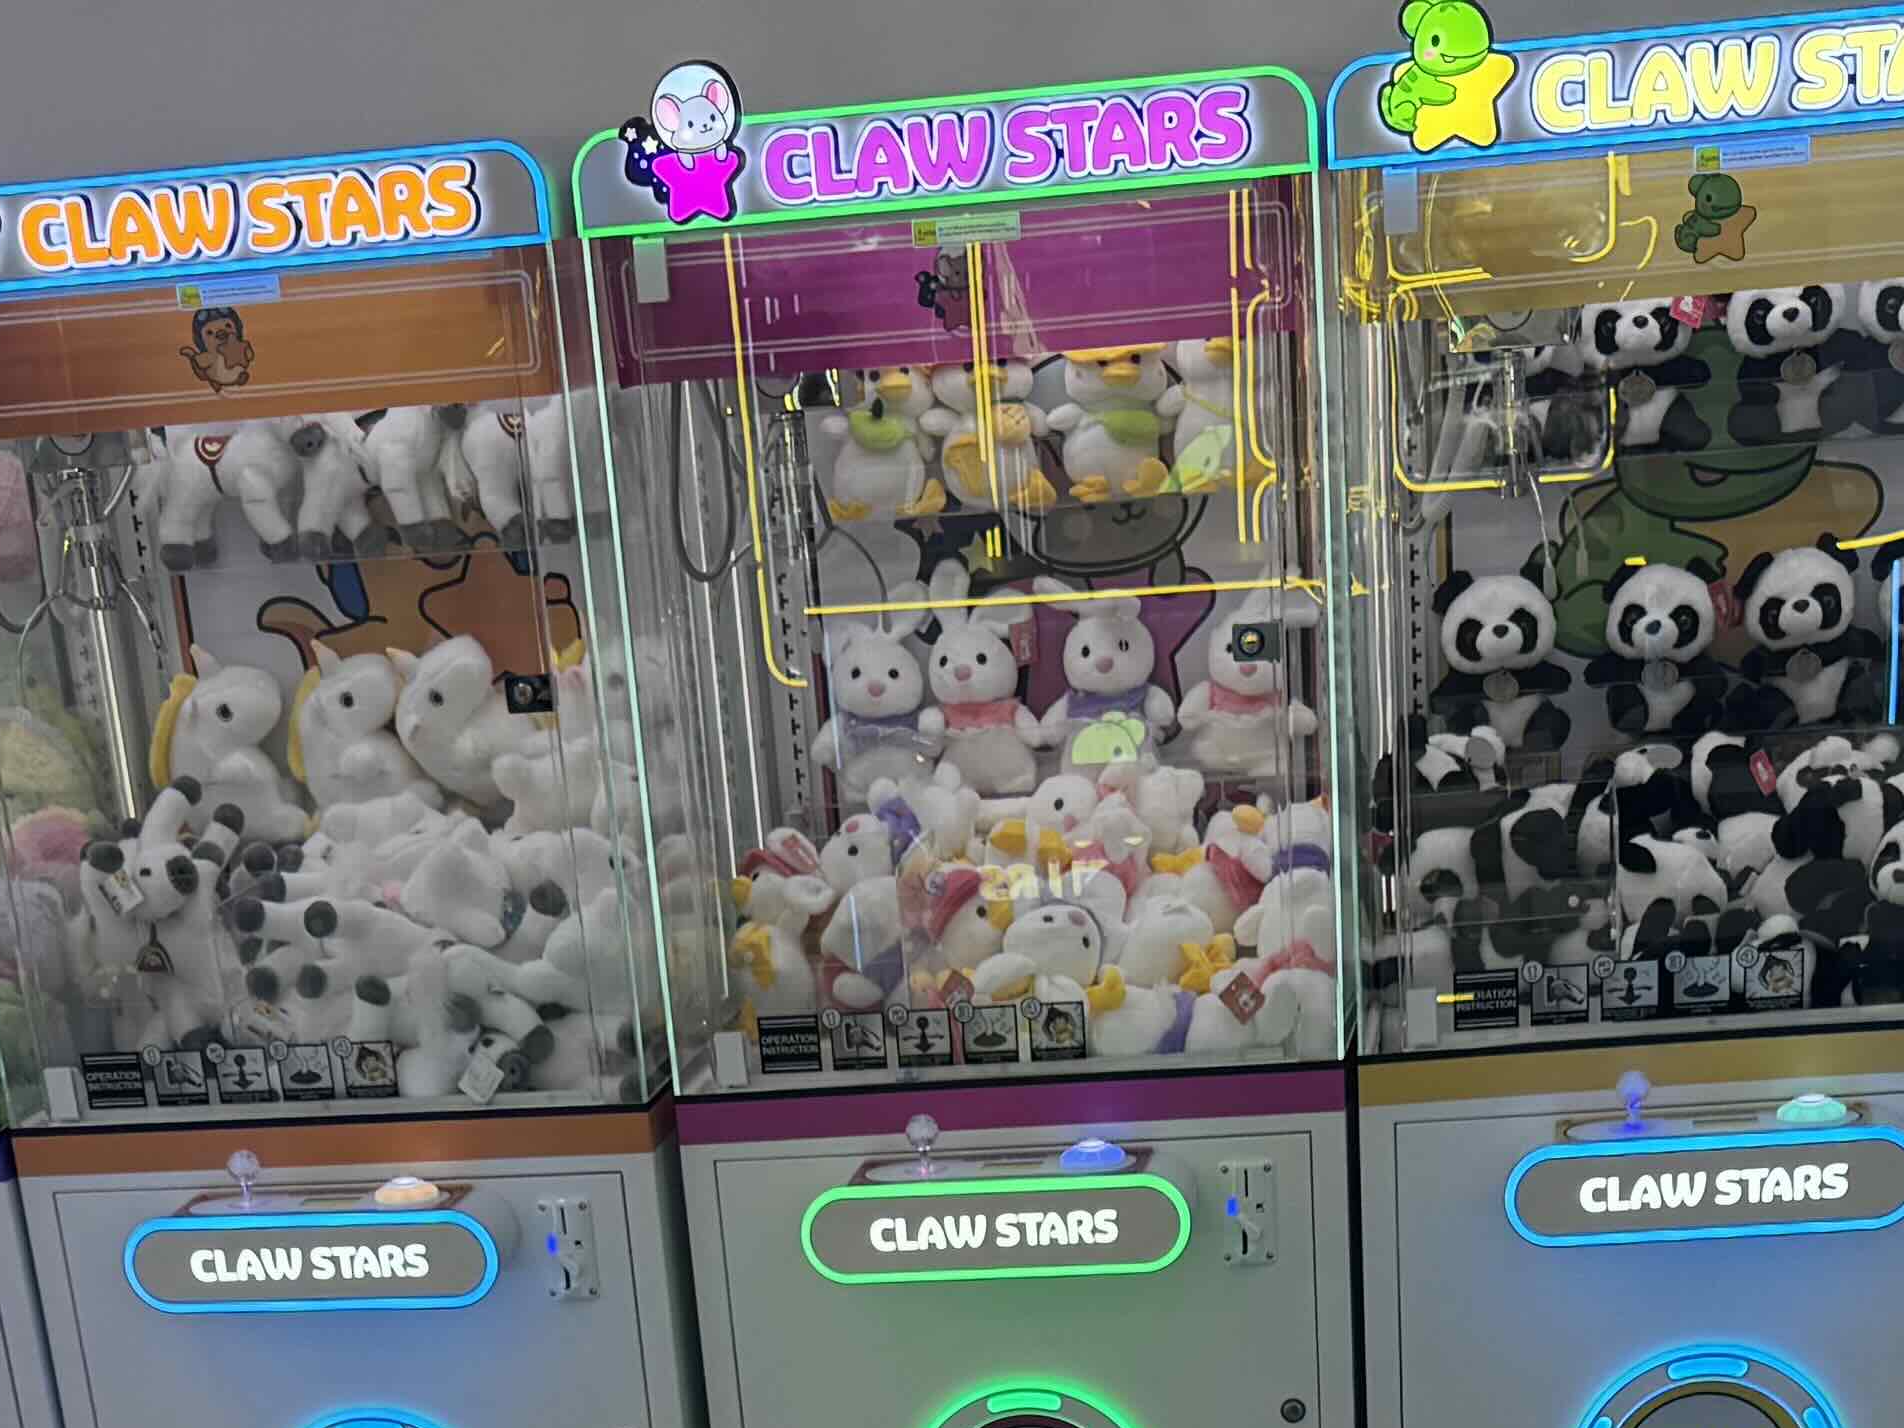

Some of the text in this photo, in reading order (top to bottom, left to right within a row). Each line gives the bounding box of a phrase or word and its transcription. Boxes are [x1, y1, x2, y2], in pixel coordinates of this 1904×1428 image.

[1532, 36, 1778, 131] CLAW
[762, 86, 1248, 204] CLAW STARS
[20, 161, 476, 269] CLAW STARS
[1580, 1164, 1849, 1213] CLAW STARS
[190, 1243, 429, 1283] CLAW STARS
[869, 1208, 1118, 1252] CLAW STARS
